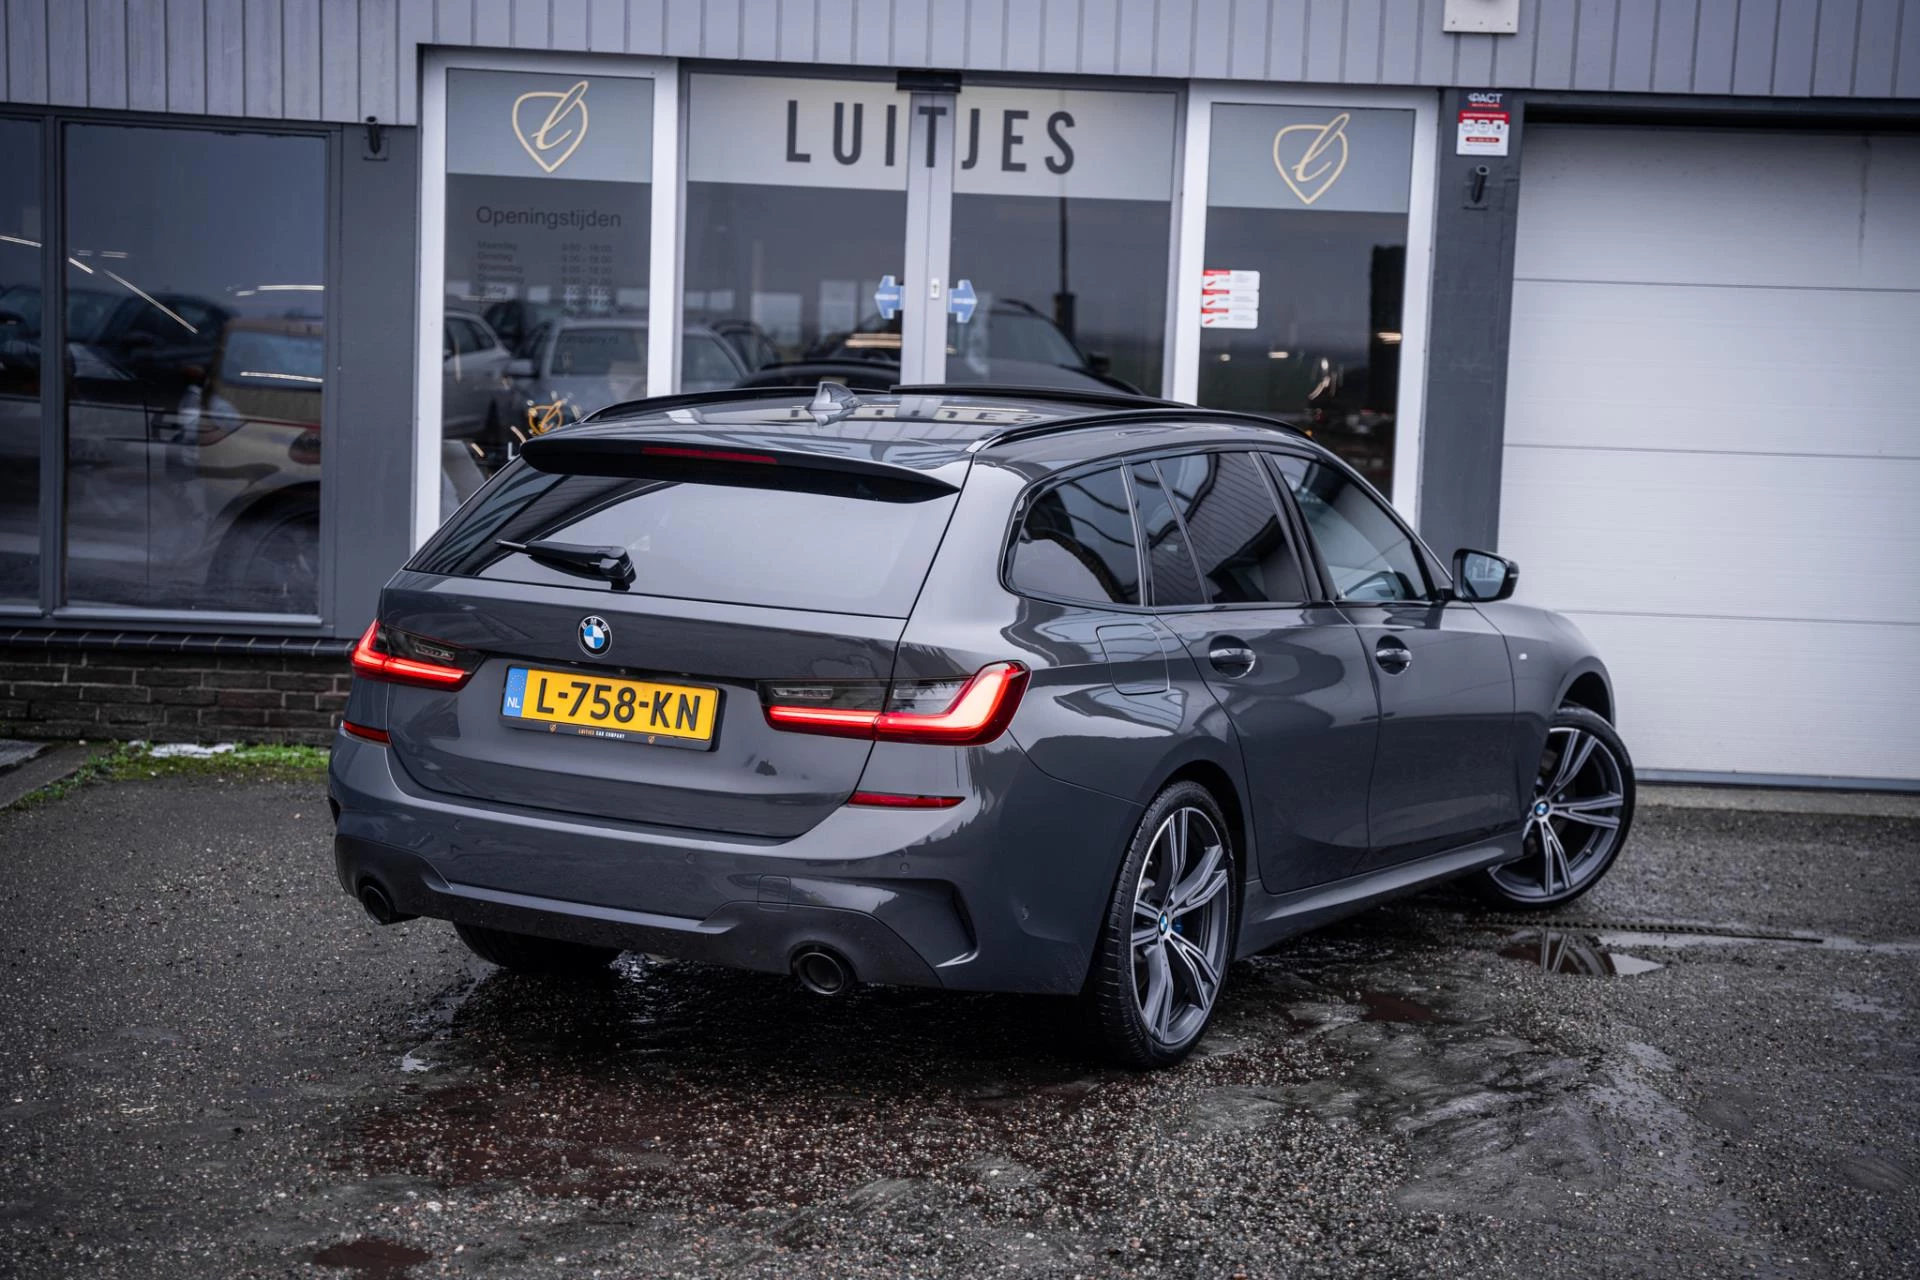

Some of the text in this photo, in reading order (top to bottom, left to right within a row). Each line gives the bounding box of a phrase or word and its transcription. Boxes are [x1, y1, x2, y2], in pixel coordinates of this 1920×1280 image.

[786, 99, 1076, 175] LUITJES
[476, 205, 622, 231] Openingstijden
[506, 697, 520, 708] NL
[536, 678, 701, 731] L-758-KN
